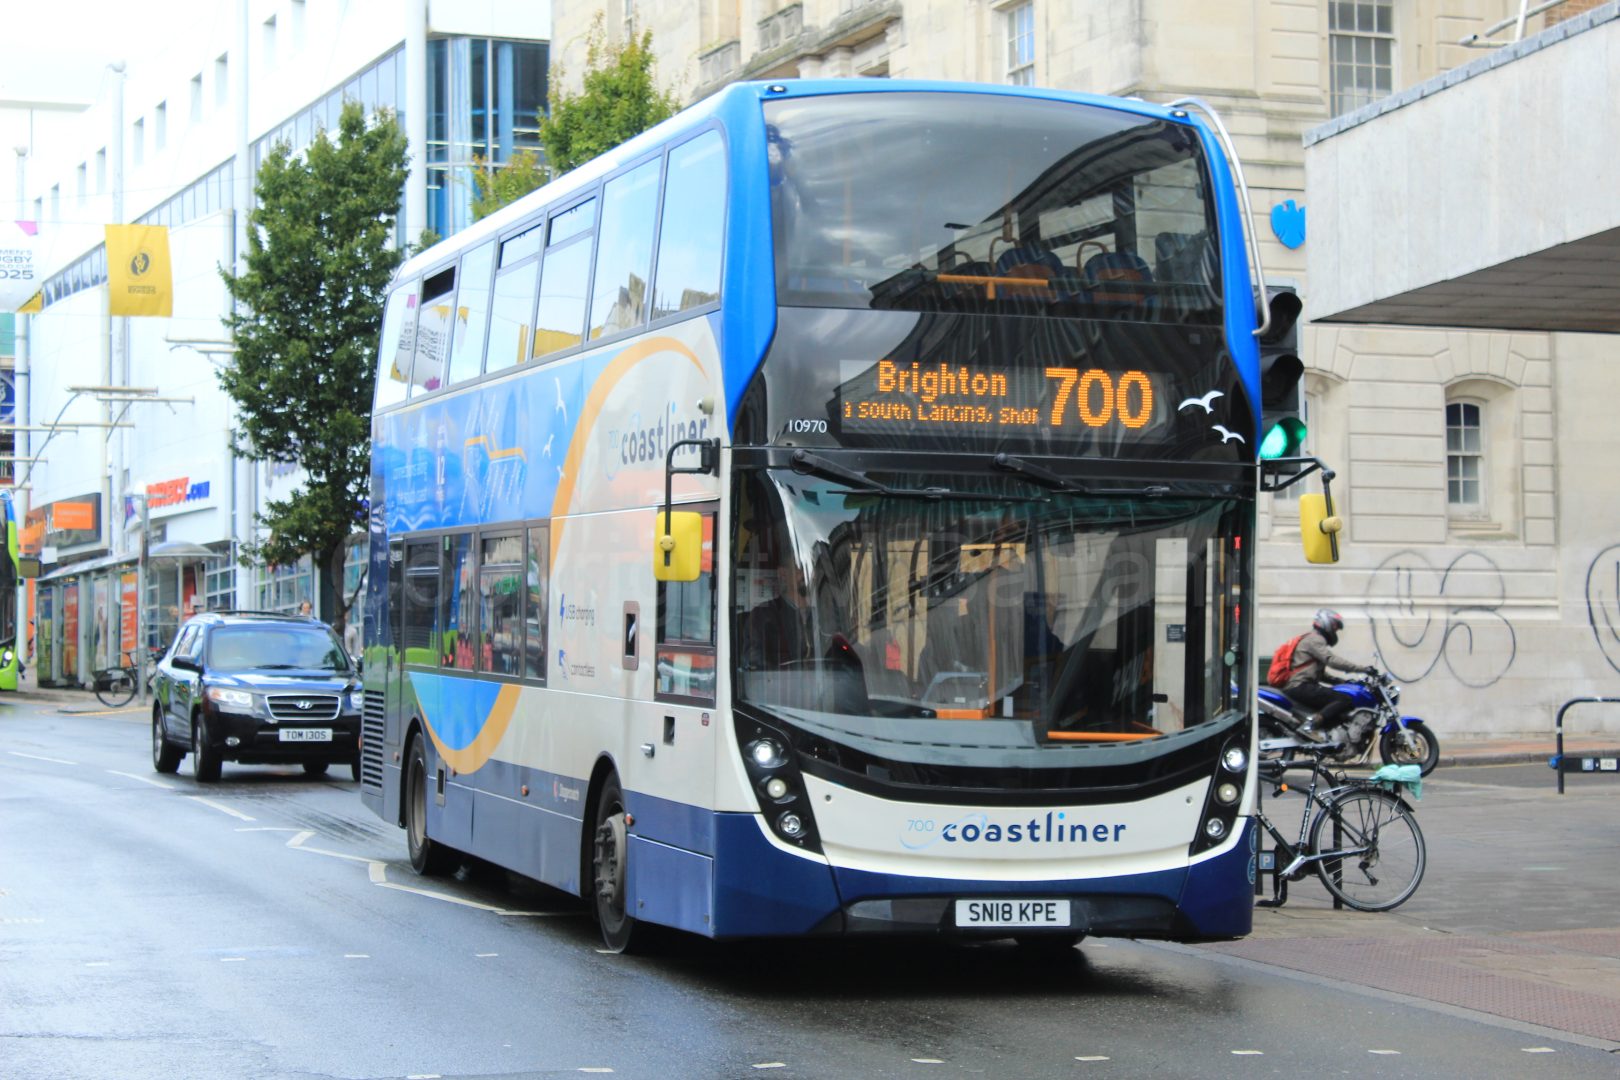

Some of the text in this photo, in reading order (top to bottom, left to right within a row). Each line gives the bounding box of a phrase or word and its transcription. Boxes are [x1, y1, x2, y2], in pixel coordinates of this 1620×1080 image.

[879, 360, 1007, 402] Brighton
[1045, 367, 1153, 428] 700
[789, 419, 828, 434] 10970
[907, 811, 1126, 843] 700 coastliner
[968, 902, 1057, 922] SN18 KPE
